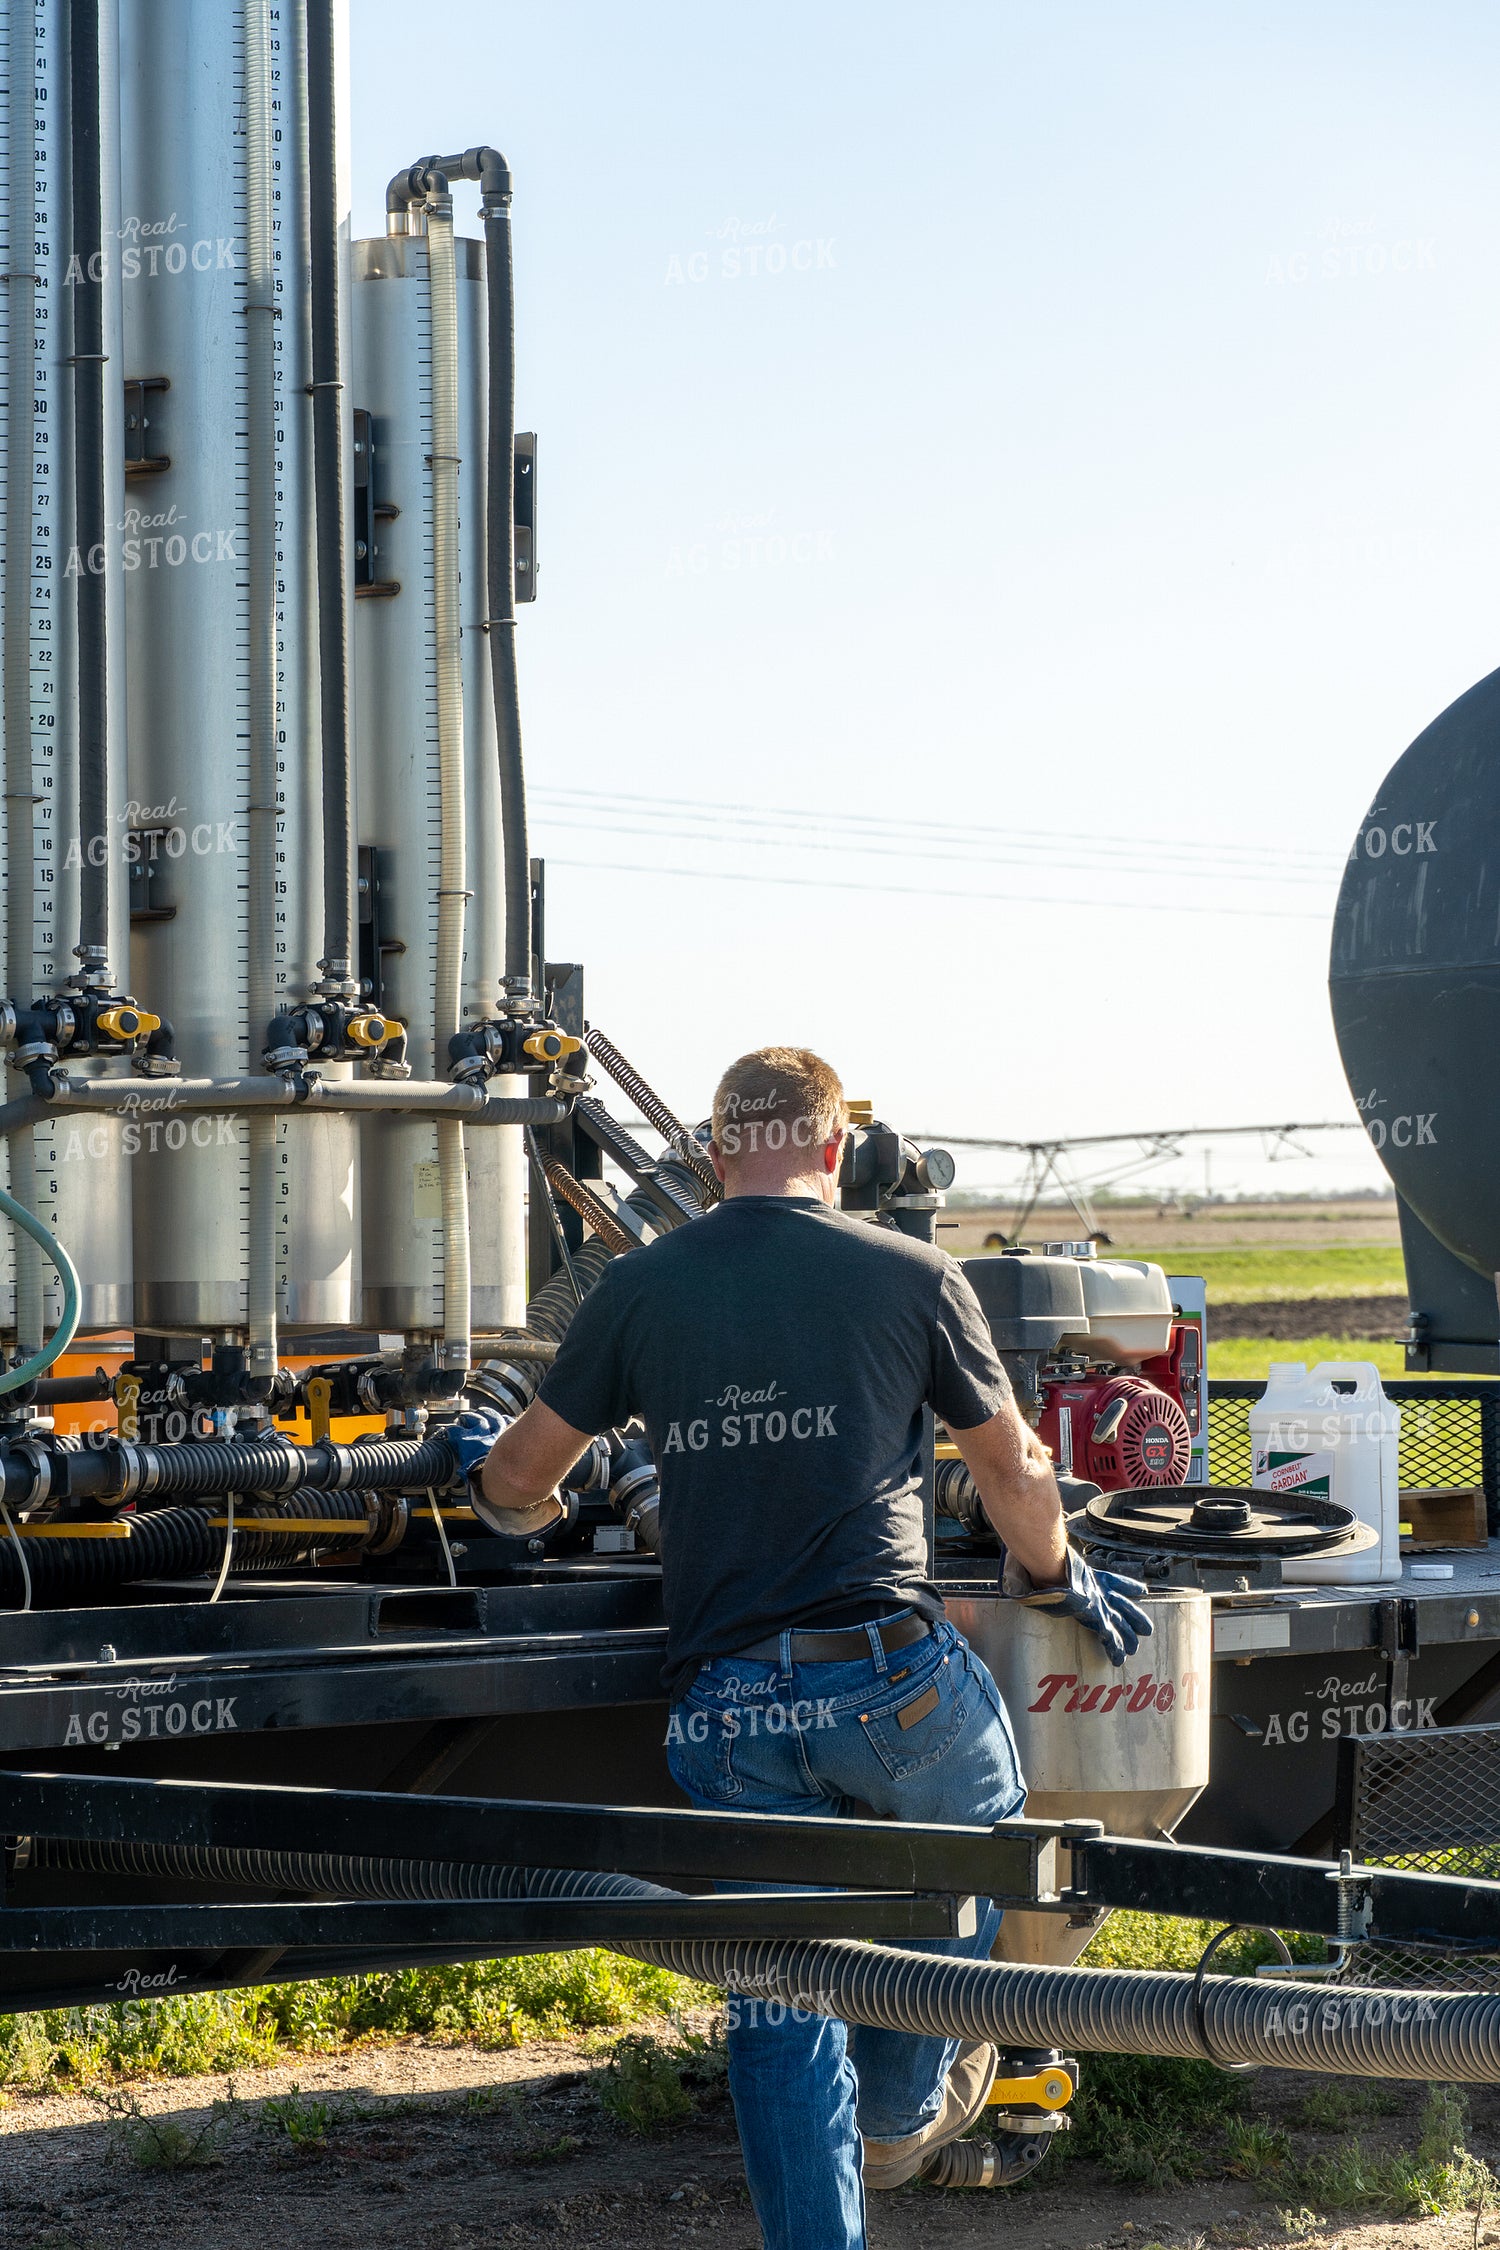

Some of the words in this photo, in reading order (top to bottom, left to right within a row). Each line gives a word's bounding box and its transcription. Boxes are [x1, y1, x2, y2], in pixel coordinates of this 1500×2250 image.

[36, 58, 46, 69] 41
[272, 101, 281, 111] 41
[34, 120, 46, 131] 39
[273, 130, 282, 142] 0
[35, 151, 46, 161] 38
[273, 161, 281, 171] 9
[35, 182, 47, 192] 37
[272, 191, 281, 201] 8
[35, 213, 47, 223] 36
[35, 243, 49, 256] 35
[273, 251, 281, 261] 6
[35, 308, 48, 319] 33
[34, 339, 45, 350] 32
[36, 371, 46, 381] 31
[34, 400, 47, 413] 30
[274, 401, 283, 411] 31
[35, 433, 48, 443] 29
[274, 430, 284, 442] 0
[36, 464, 49, 474] 28
[38, 495, 49, 505] 27
[37, 526, 50, 537] 26
[36, 556, 51, 569] 25
[275, 580, 285, 592] 5
[36, 587, 50, 599] 24
[38, 620, 51, 630] 23
[276, 642, 284, 651] 3
[39, 651, 52, 661] 22
[276, 672, 284, 681] 2
[43, 683, 53, 693] 21
[276, 702, 285, 712] 21
[38, 715, 55, 727] 20
[43, 746, 53, 757] 19
[43, 777, 53, 788] 18
[43, 808, 52, 819] 17
[276, 823, 285, 832] 17
[42, 839, 52, 850] 16
[275, 852, 285, 862] 16
[41, 870, 53, 882] 15
[275, 881, 287, 894] 15
[43, 902, 53, 912] 14
[276, 913, 286, 923] 14
[43, 933, 53, 943] 13
[276, 943, 286, 953] 13
[43, 964, 53, 975] 12
[276, 973, 286, 983] 12
[280, 1003, 287, 1013] 11
[463, 1007, 469, 1017] 6
[51, 1120, 56, 1130] 7
[282, 1124, 288, 1134] 7
[50, 1151, 56, 1161] 6
[282, 1154, 288, 1164] 6
[50, 1181, 58, 1193] 5
[281, 1183, 289, 1195] 5
[51, 1213, 57, 1223] 4
[282, 1214, 288, 1224] 4
[282, 1245, 288, 1254] 3
[54, 1275, 60, 1285] 2
[282, 1275, 288, 1285] 2
[1145, 1445, 1168, 1457] GX
[1270, 1470, 1307, 1491] GARDIAN
[1027, 1673, 1176, 1714] Turbo
